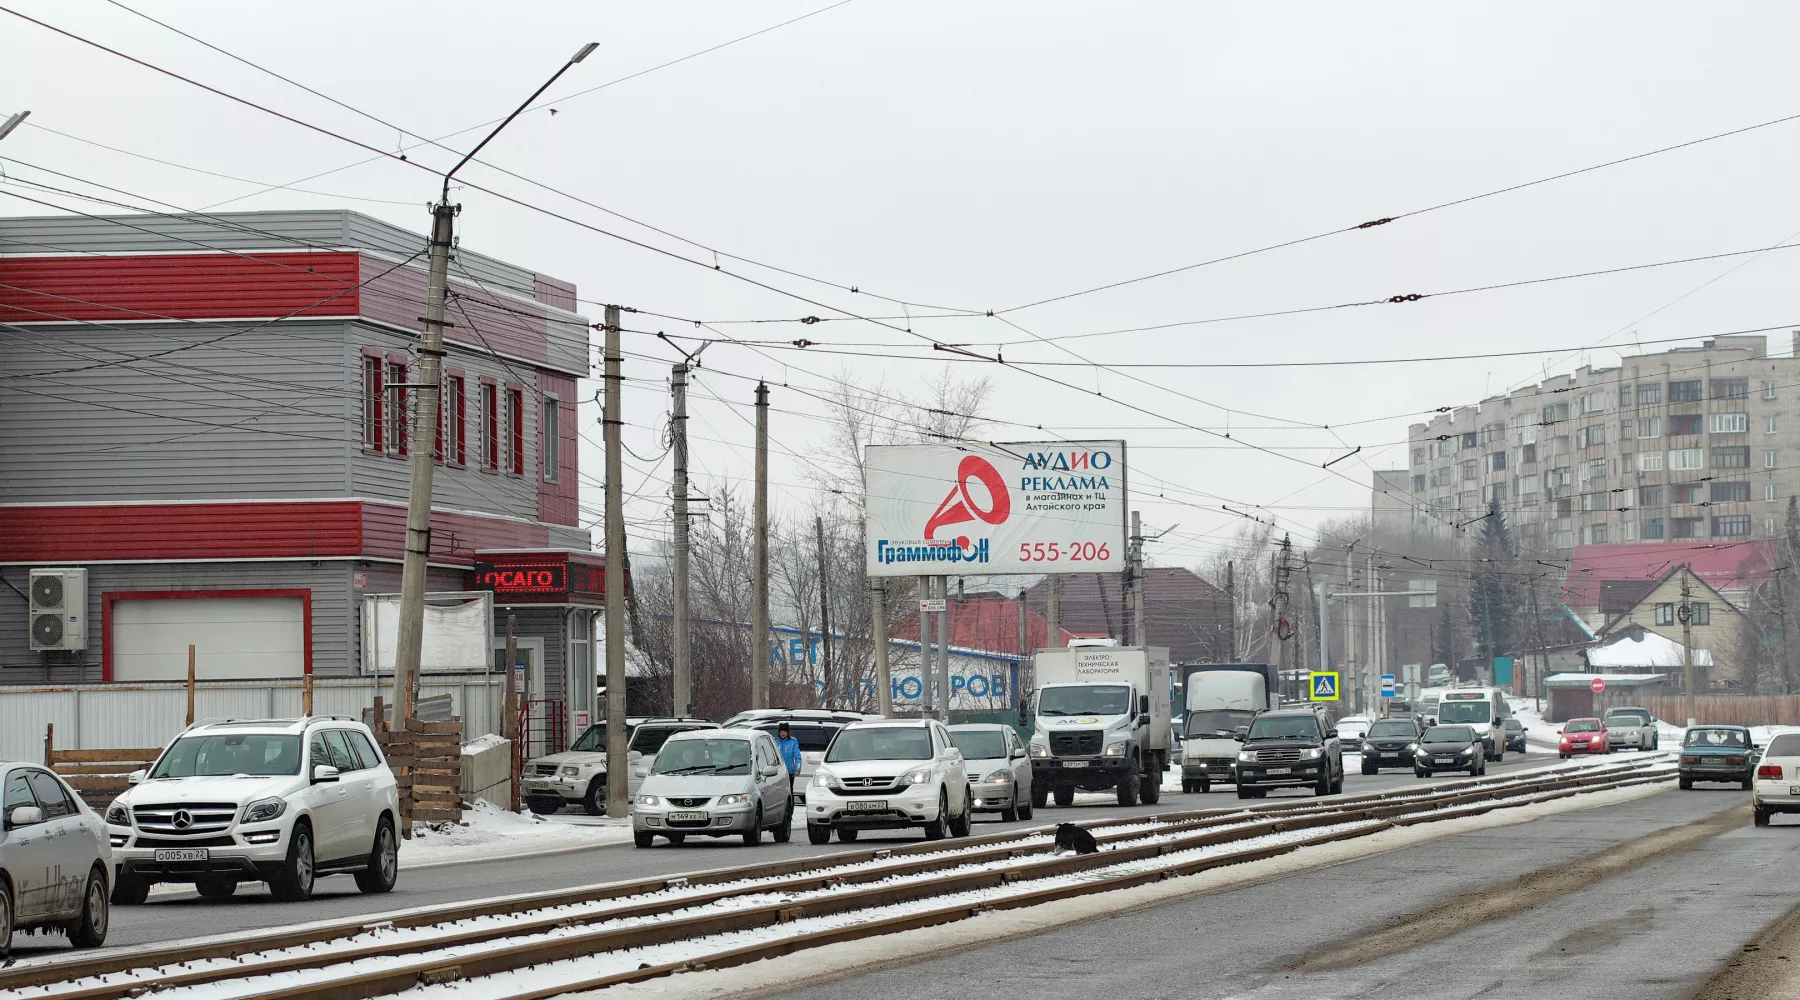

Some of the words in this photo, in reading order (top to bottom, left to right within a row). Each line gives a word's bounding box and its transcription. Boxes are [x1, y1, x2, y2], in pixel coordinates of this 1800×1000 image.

[1022, 451, 1112, 470] АУДИО
[1021, 475, 1110, 491] РЕКЛАМА
[1033, 493, 1084, 502] магазинах
[1094, 492, 1106, 502] ТЦ
[1025, 502, 1081, 512] Алтайского
[1083, 503, 1106, 513] края
[1019, 540, 1111, 563] 555-206
[1077, 667, 1120, 675] ЛАБОРАТОРИЯ
